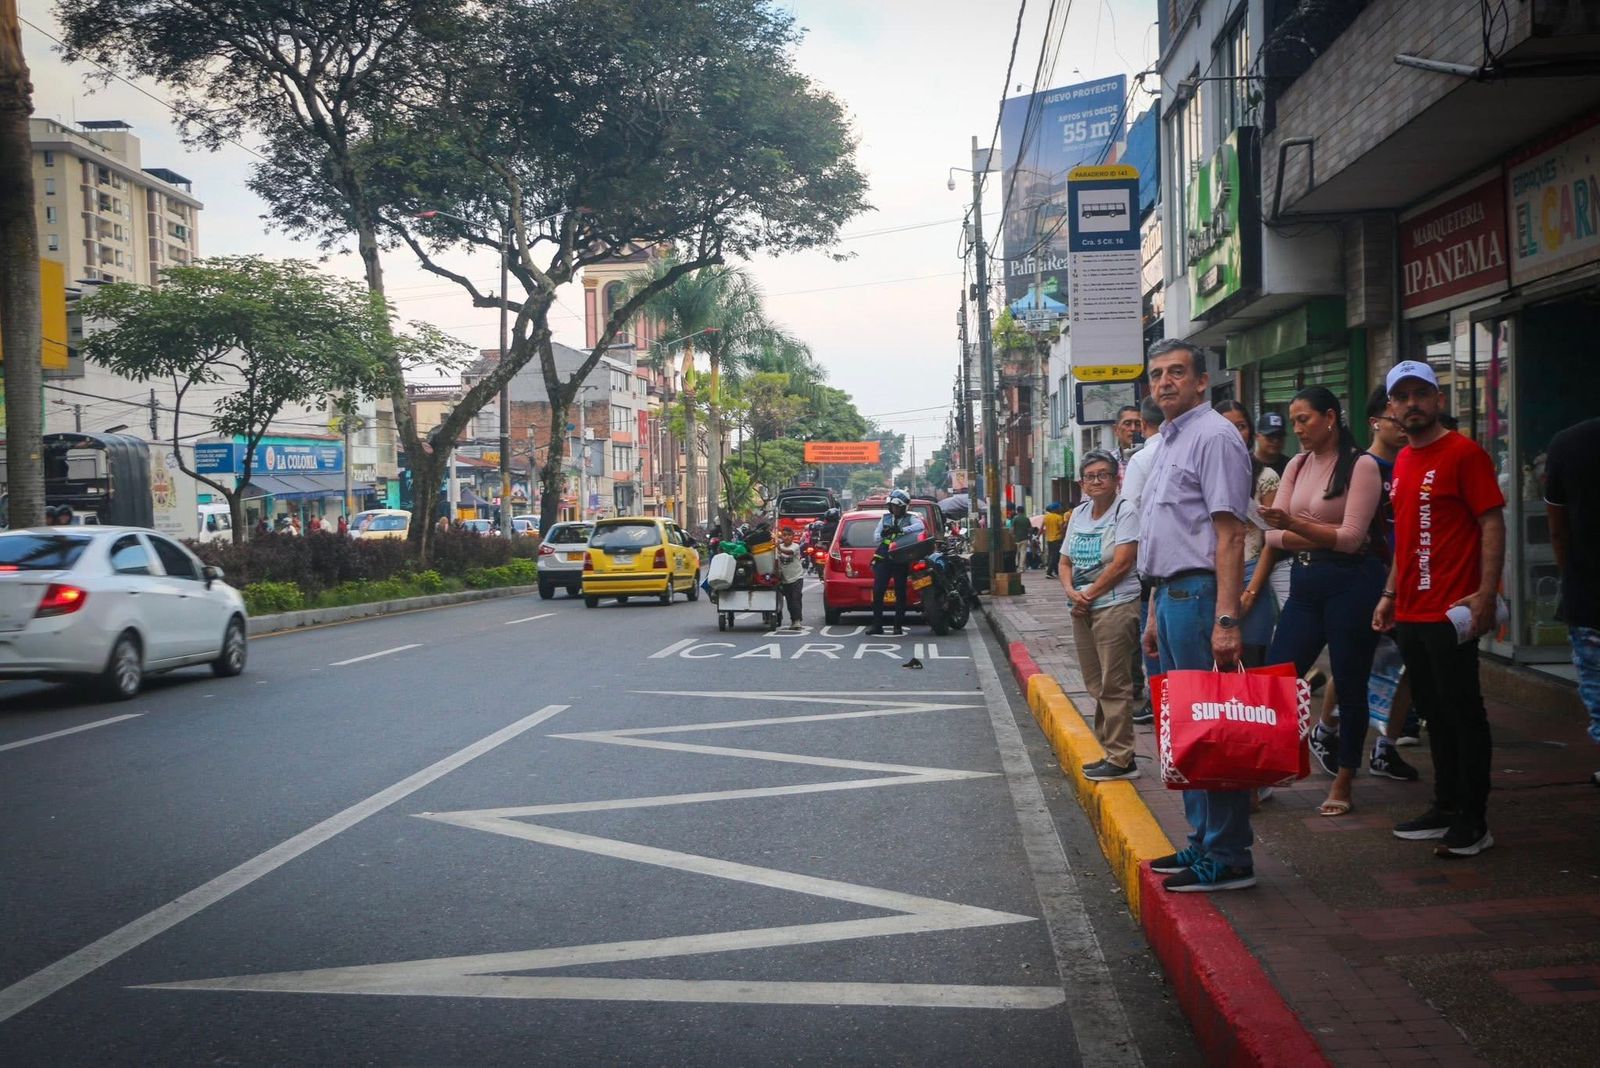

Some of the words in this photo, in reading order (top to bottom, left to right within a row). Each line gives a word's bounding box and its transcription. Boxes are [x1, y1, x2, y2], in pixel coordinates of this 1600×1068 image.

[1072, 82, 1118, 99] PROYECTO
[1094, 104, 1118, 115] DESDE
[1063, 121, 1088, 144] 55
[1412, 200, 1485, 248] MARQUETERIA
[1517, 200, 1538, 259] EL
[1403, 230, 1505, 297] IPANEMA
[276, 455, 286, 470] LA
[287, 454, 318, 470] COLONIA
[1419, 503, 1432, 530] UNA
[1419, 531, 1432, 546] ES
[678, 642, 970, 660] CARRIL
[1191, 698, 1277, 727] surtitodo
